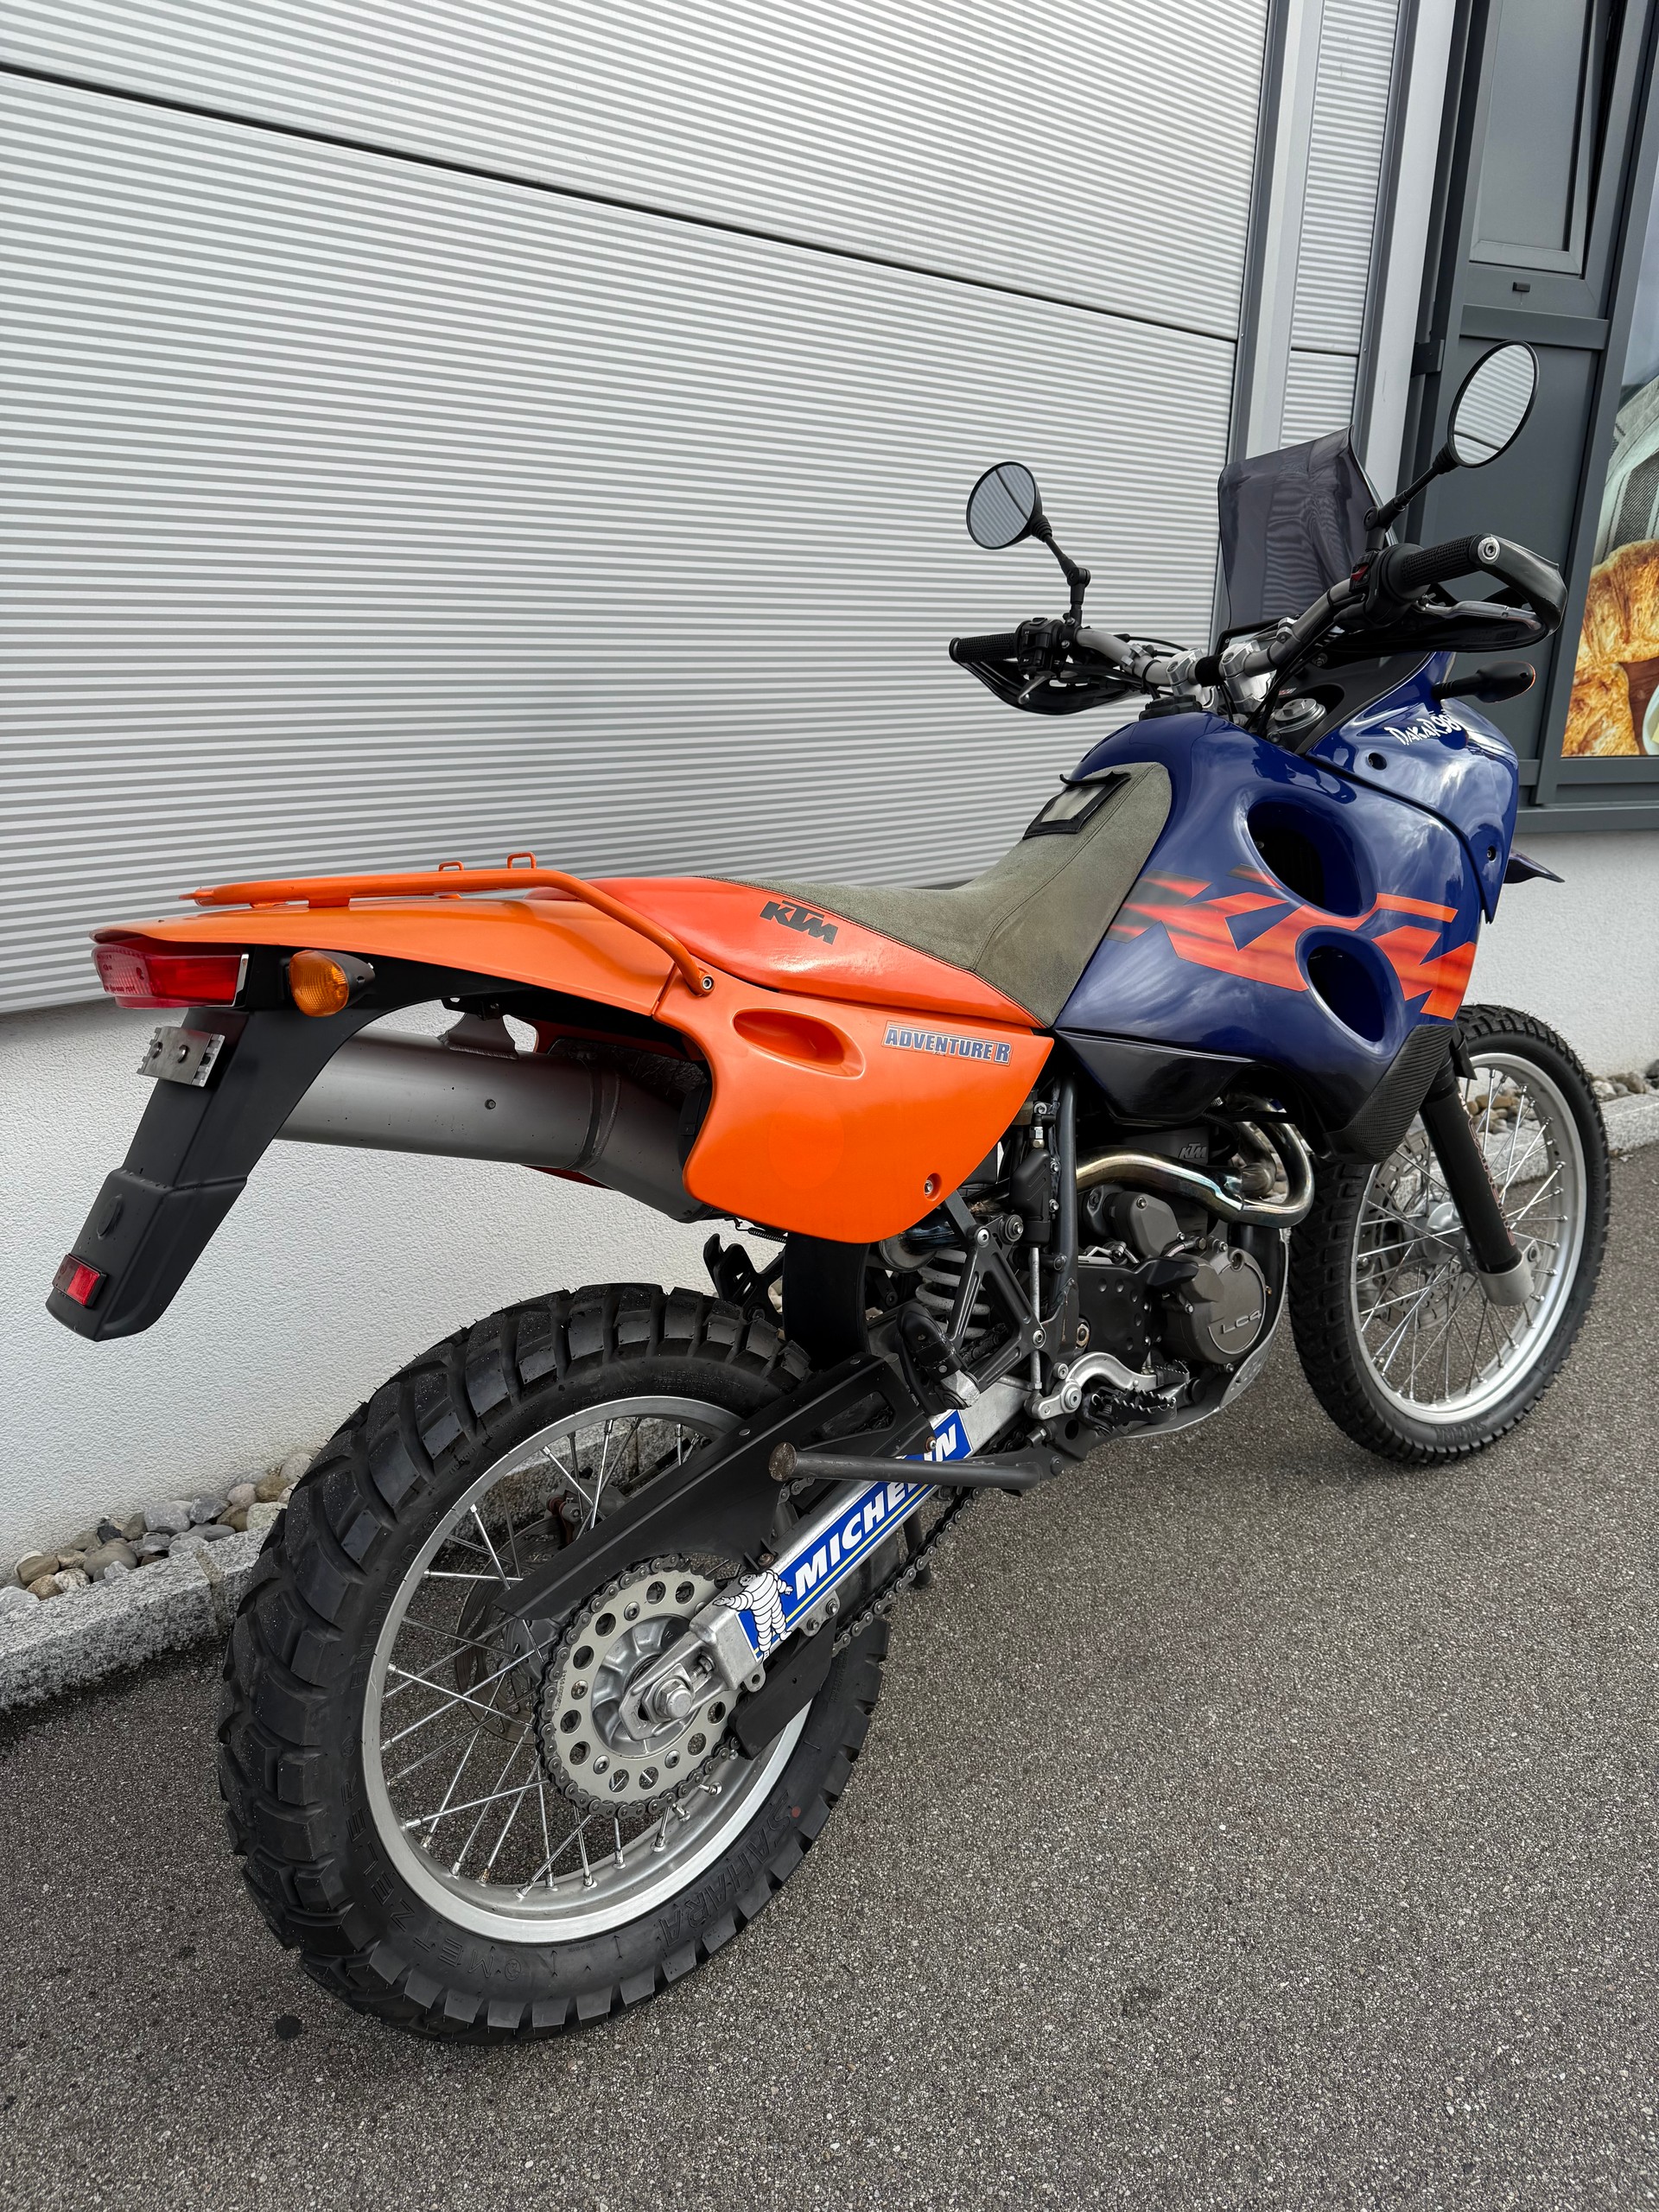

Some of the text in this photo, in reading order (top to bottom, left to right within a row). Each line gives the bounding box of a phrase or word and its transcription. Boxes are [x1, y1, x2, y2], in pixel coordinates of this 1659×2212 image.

[760, 900, 839, 945] KTM
[884, 1028, 1012, 1065] ADVENTURE R
[1179, 1142, 1208, 1160] KTM
[1222, 1310, 1262, 1334] LC4
[793, 1423, 957, 1600] MICHEN
[341, 1774, 494, 1978] METZELER
[659, 1789, 791, 1947] SAHARA
